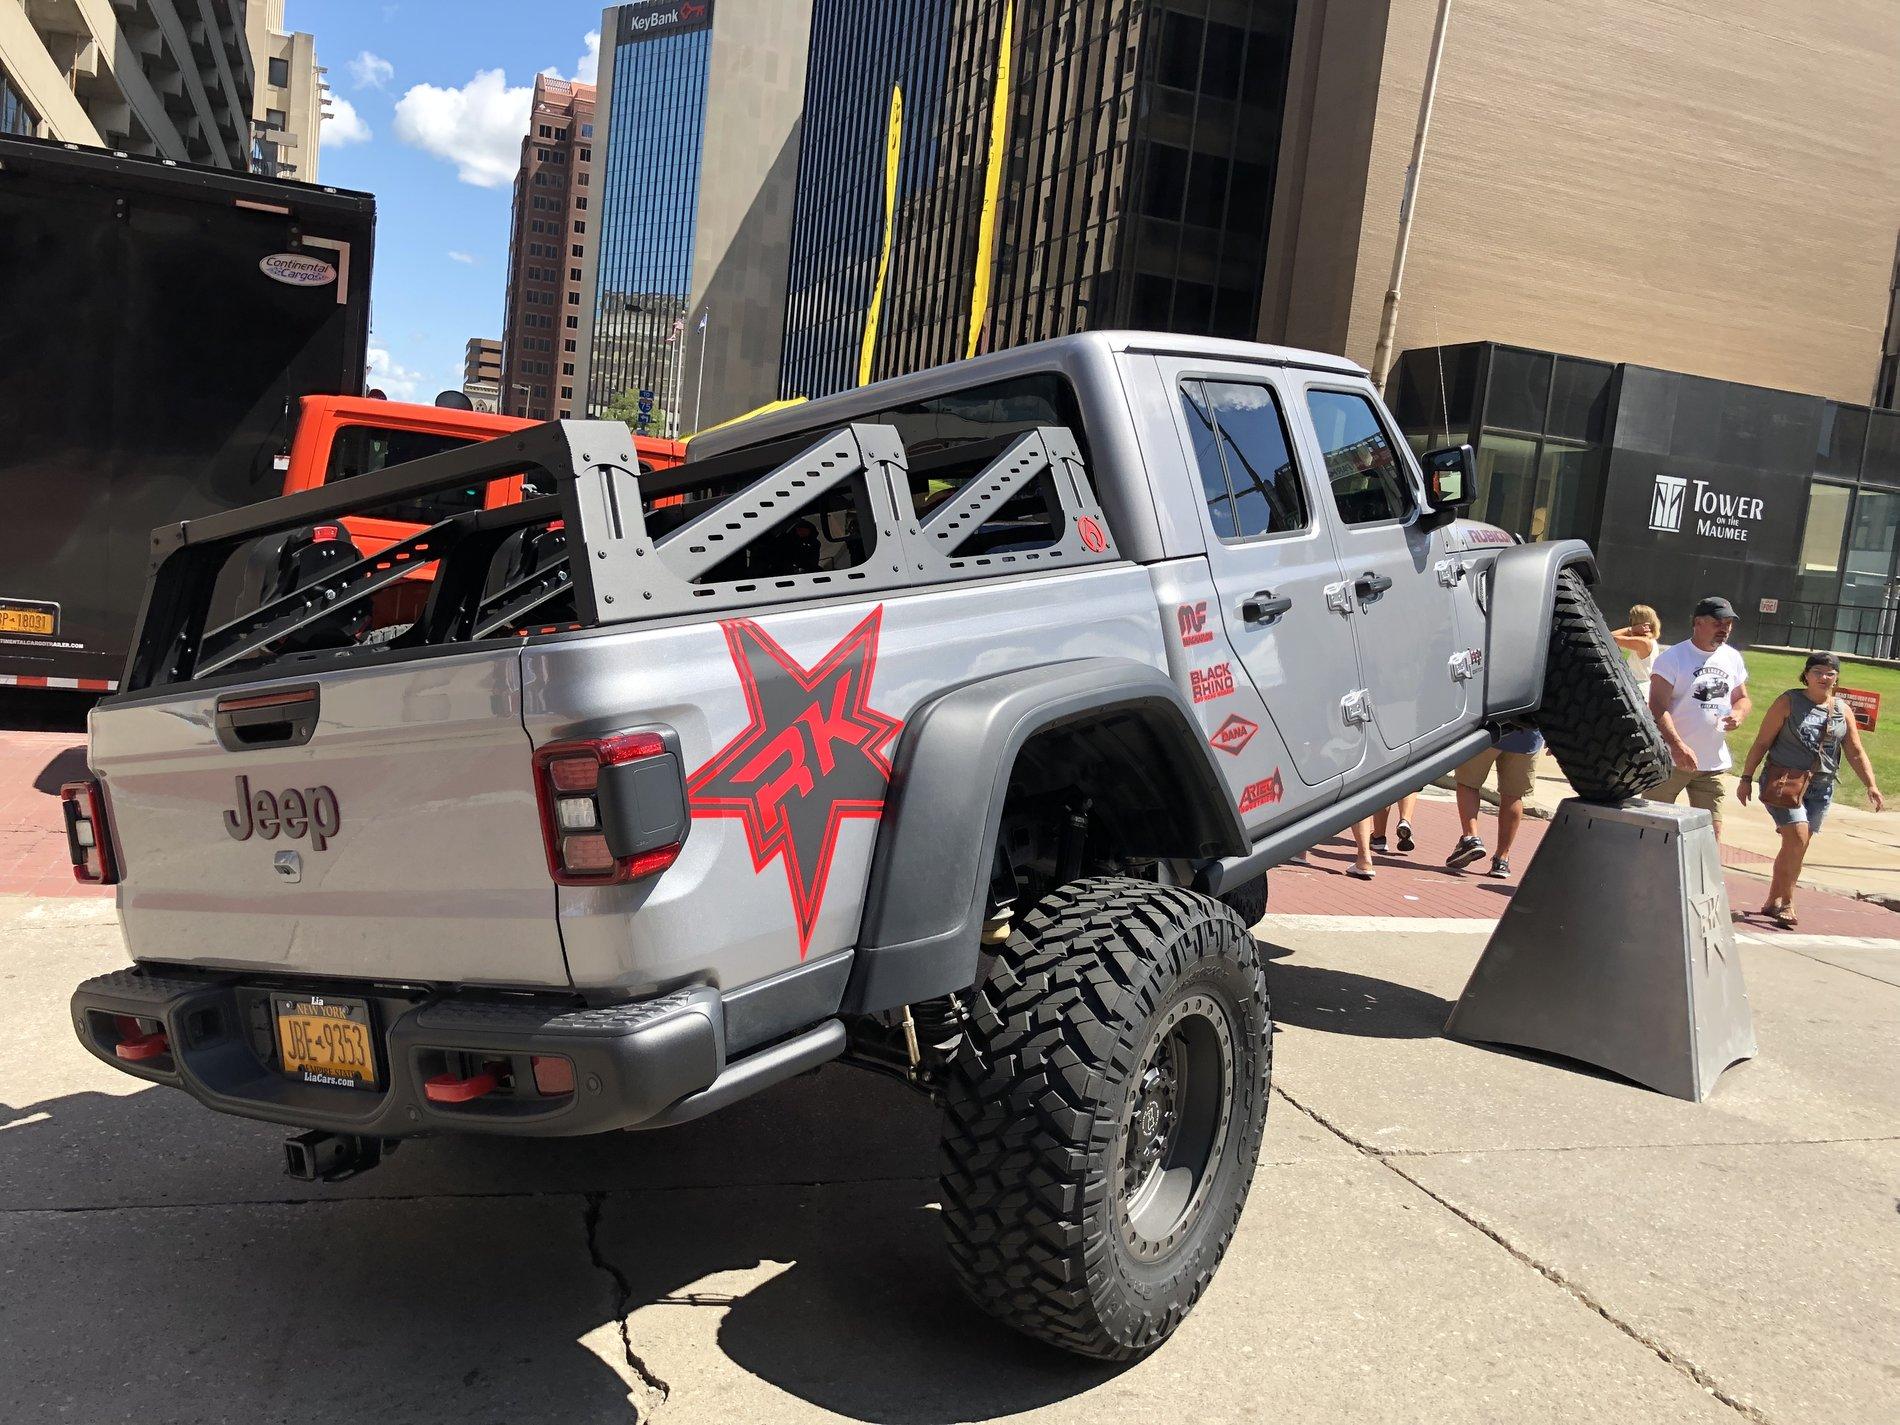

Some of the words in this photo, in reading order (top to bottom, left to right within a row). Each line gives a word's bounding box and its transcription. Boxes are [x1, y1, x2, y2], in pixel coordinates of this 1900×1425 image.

[631, 9, 679, 31] KeyBank
[266, 257, 329, 274] Continental
[281, 268, 314, 281] Cargo
[641, 402, 651, 410] 75
[1692, 479, 1764, 520] TOWER
[1716, 516, 1726, 525] ON
[1696, 518, 1748, 542] MAUMEE
[1189, 662, 1232, 686] BLACK
[1192, 676, 1234, 699] RHINO
[1221, 725, 1248, 743] DANA
[223, 774, 340, 851] Jeep
[311, 996, 324, 1006] Lia
[297, 1003, 317, 1016] NEW
[320, 1006, 346, 1019] YORK
[288, 1020, 317, 1061] JBE
[323, 1023, 366, 1066] 9353
[304, 1072, 355, 1087] LiaCars.com
